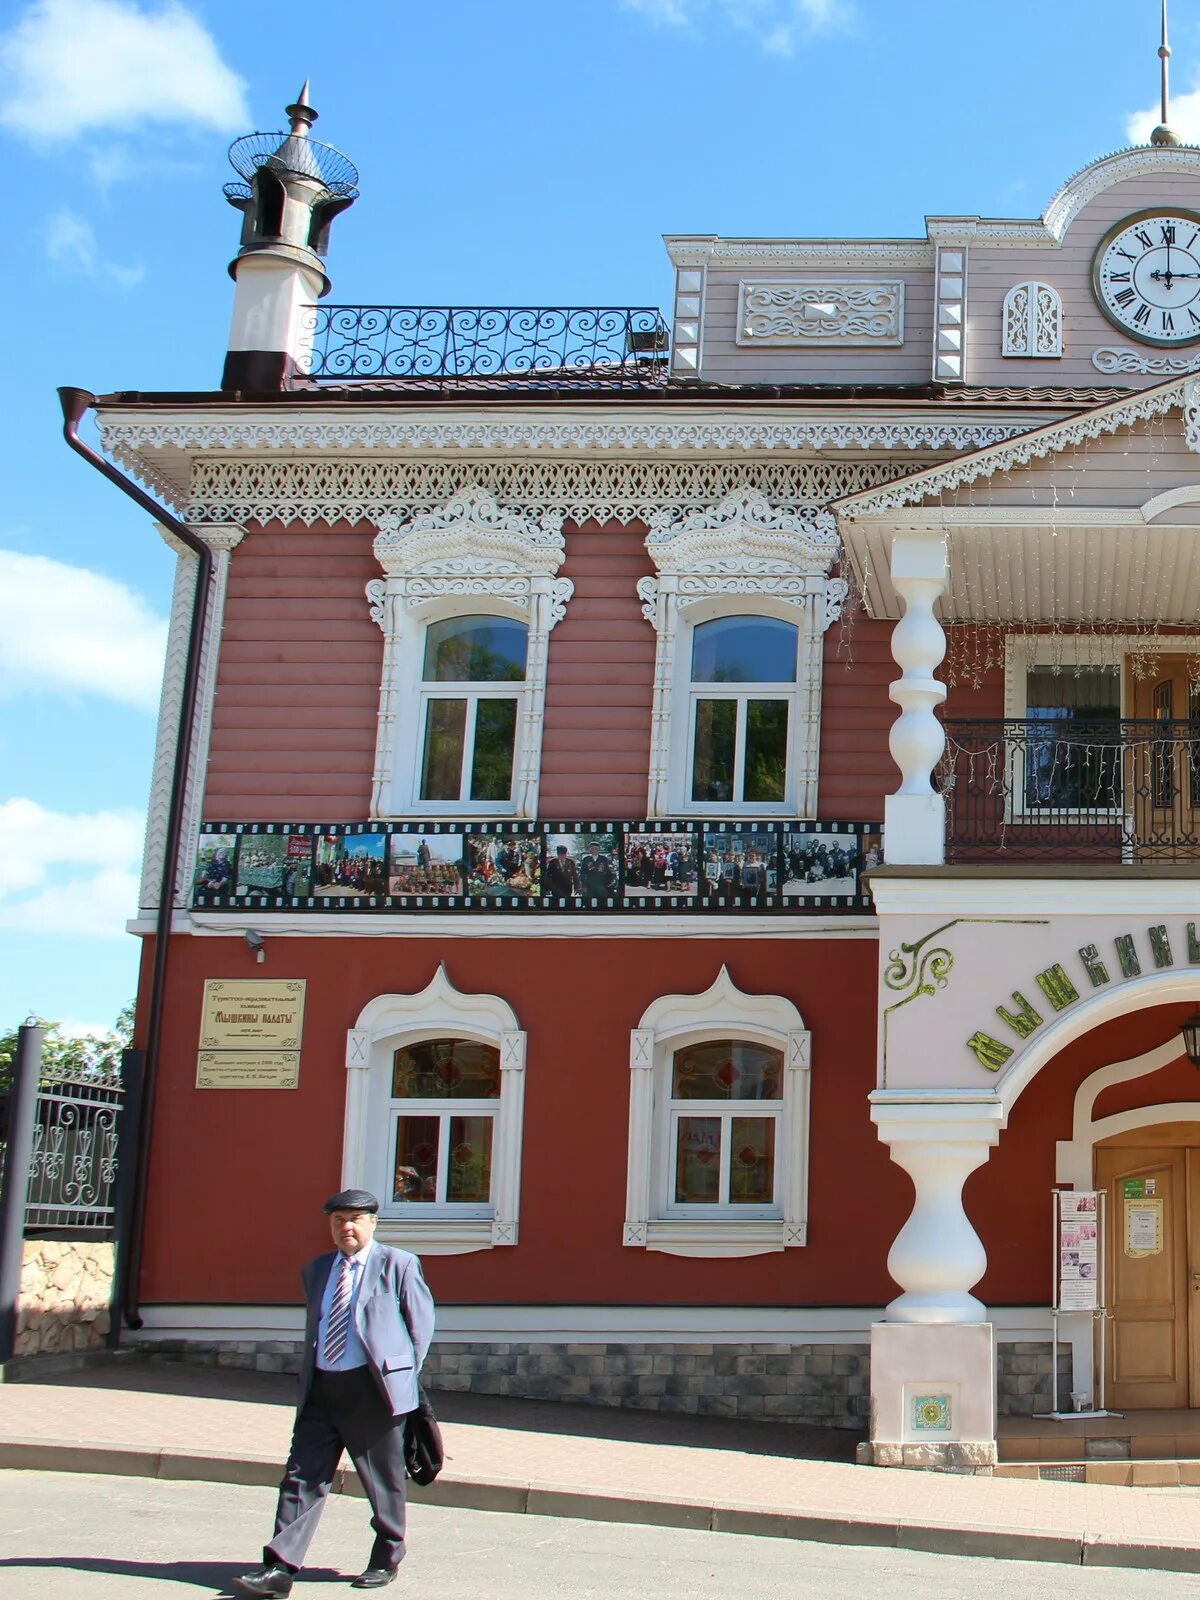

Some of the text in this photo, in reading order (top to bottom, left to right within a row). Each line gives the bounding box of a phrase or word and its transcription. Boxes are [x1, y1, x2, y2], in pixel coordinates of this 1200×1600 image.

[1134, 230, 1154, 251] XI
[1160, 226, 1176, 244] XII
[1186, 233, 1198, 249] I
[1116, 247, 1137, 264] X
[1110, 271, 1131, 283] IX
[1114, 287, 1138, 310] VIII
[1133, 303, 1152, 326] VII
[1162, 311, 1175, 330] VI
